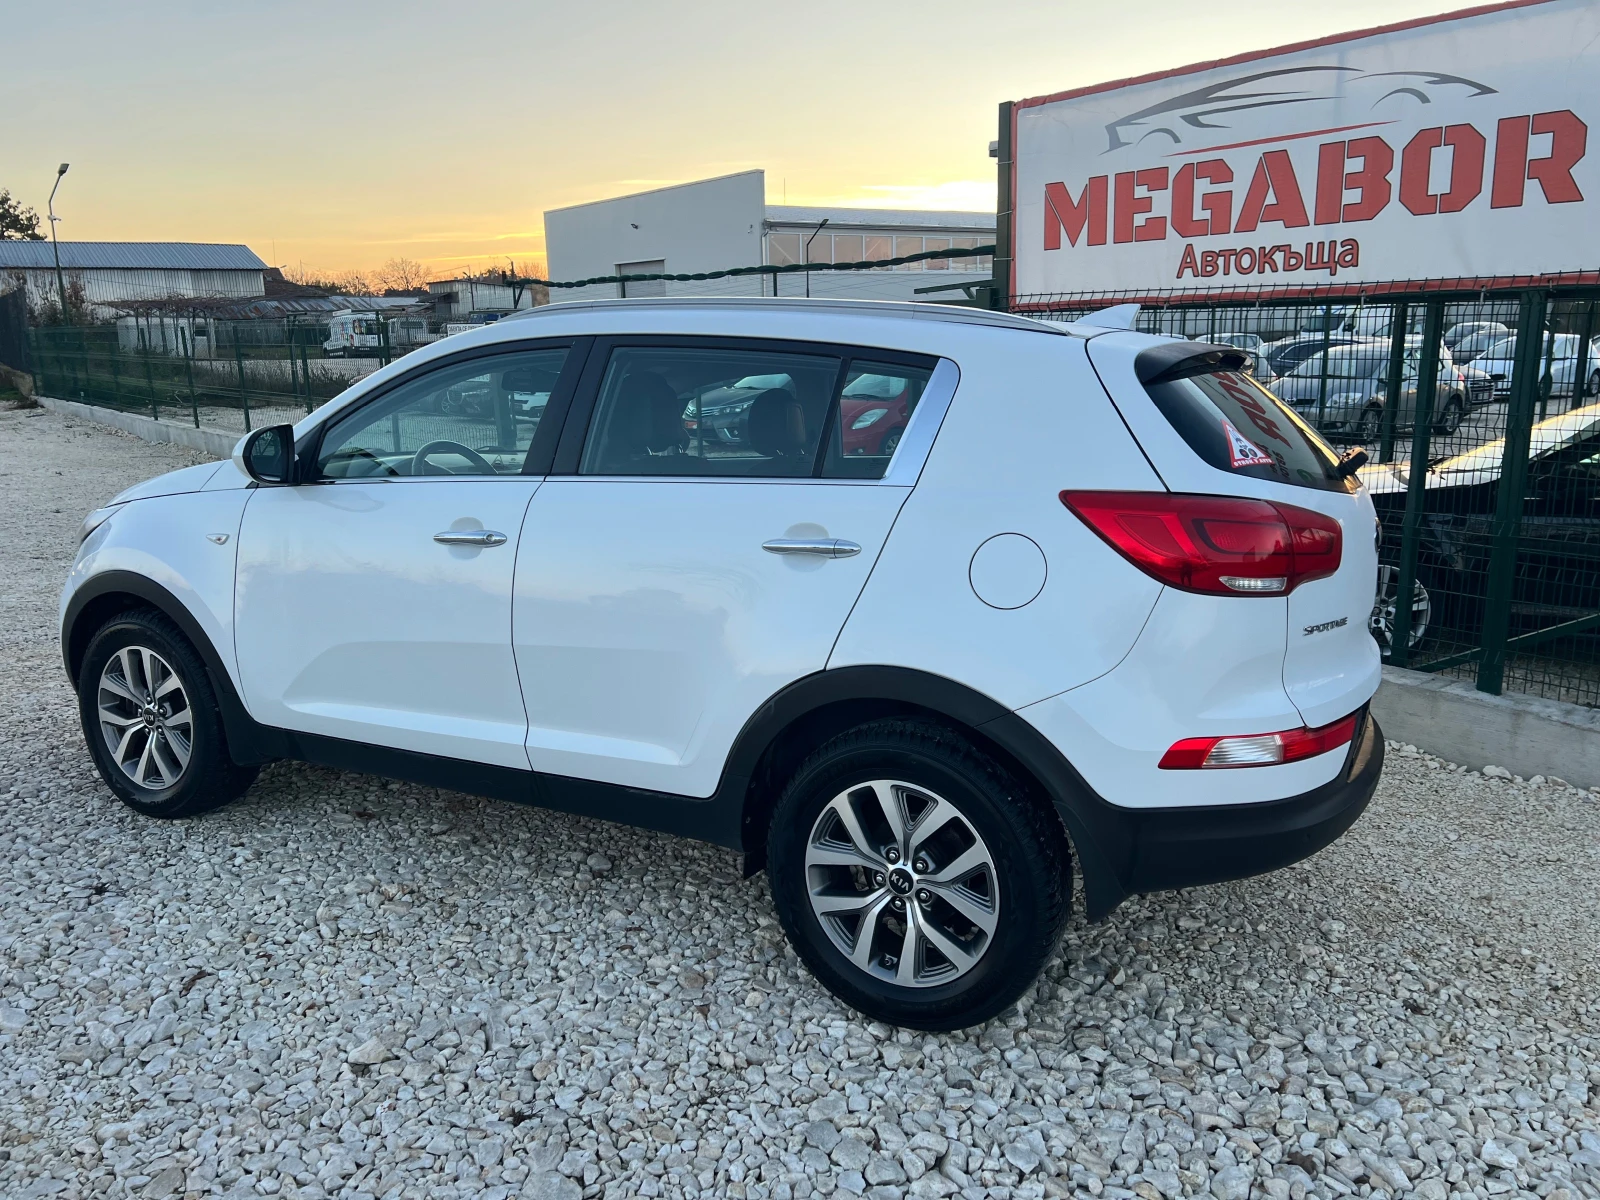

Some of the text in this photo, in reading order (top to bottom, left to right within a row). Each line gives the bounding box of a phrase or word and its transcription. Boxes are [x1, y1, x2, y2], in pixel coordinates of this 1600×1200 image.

[1044, 109, 1588, 251] MEGABOR
[1176, 237, 1360, 279] Автокъща
[1302, 616, 1348, 636] SPORTAGE
[891, 873, 909, 891] KIA
